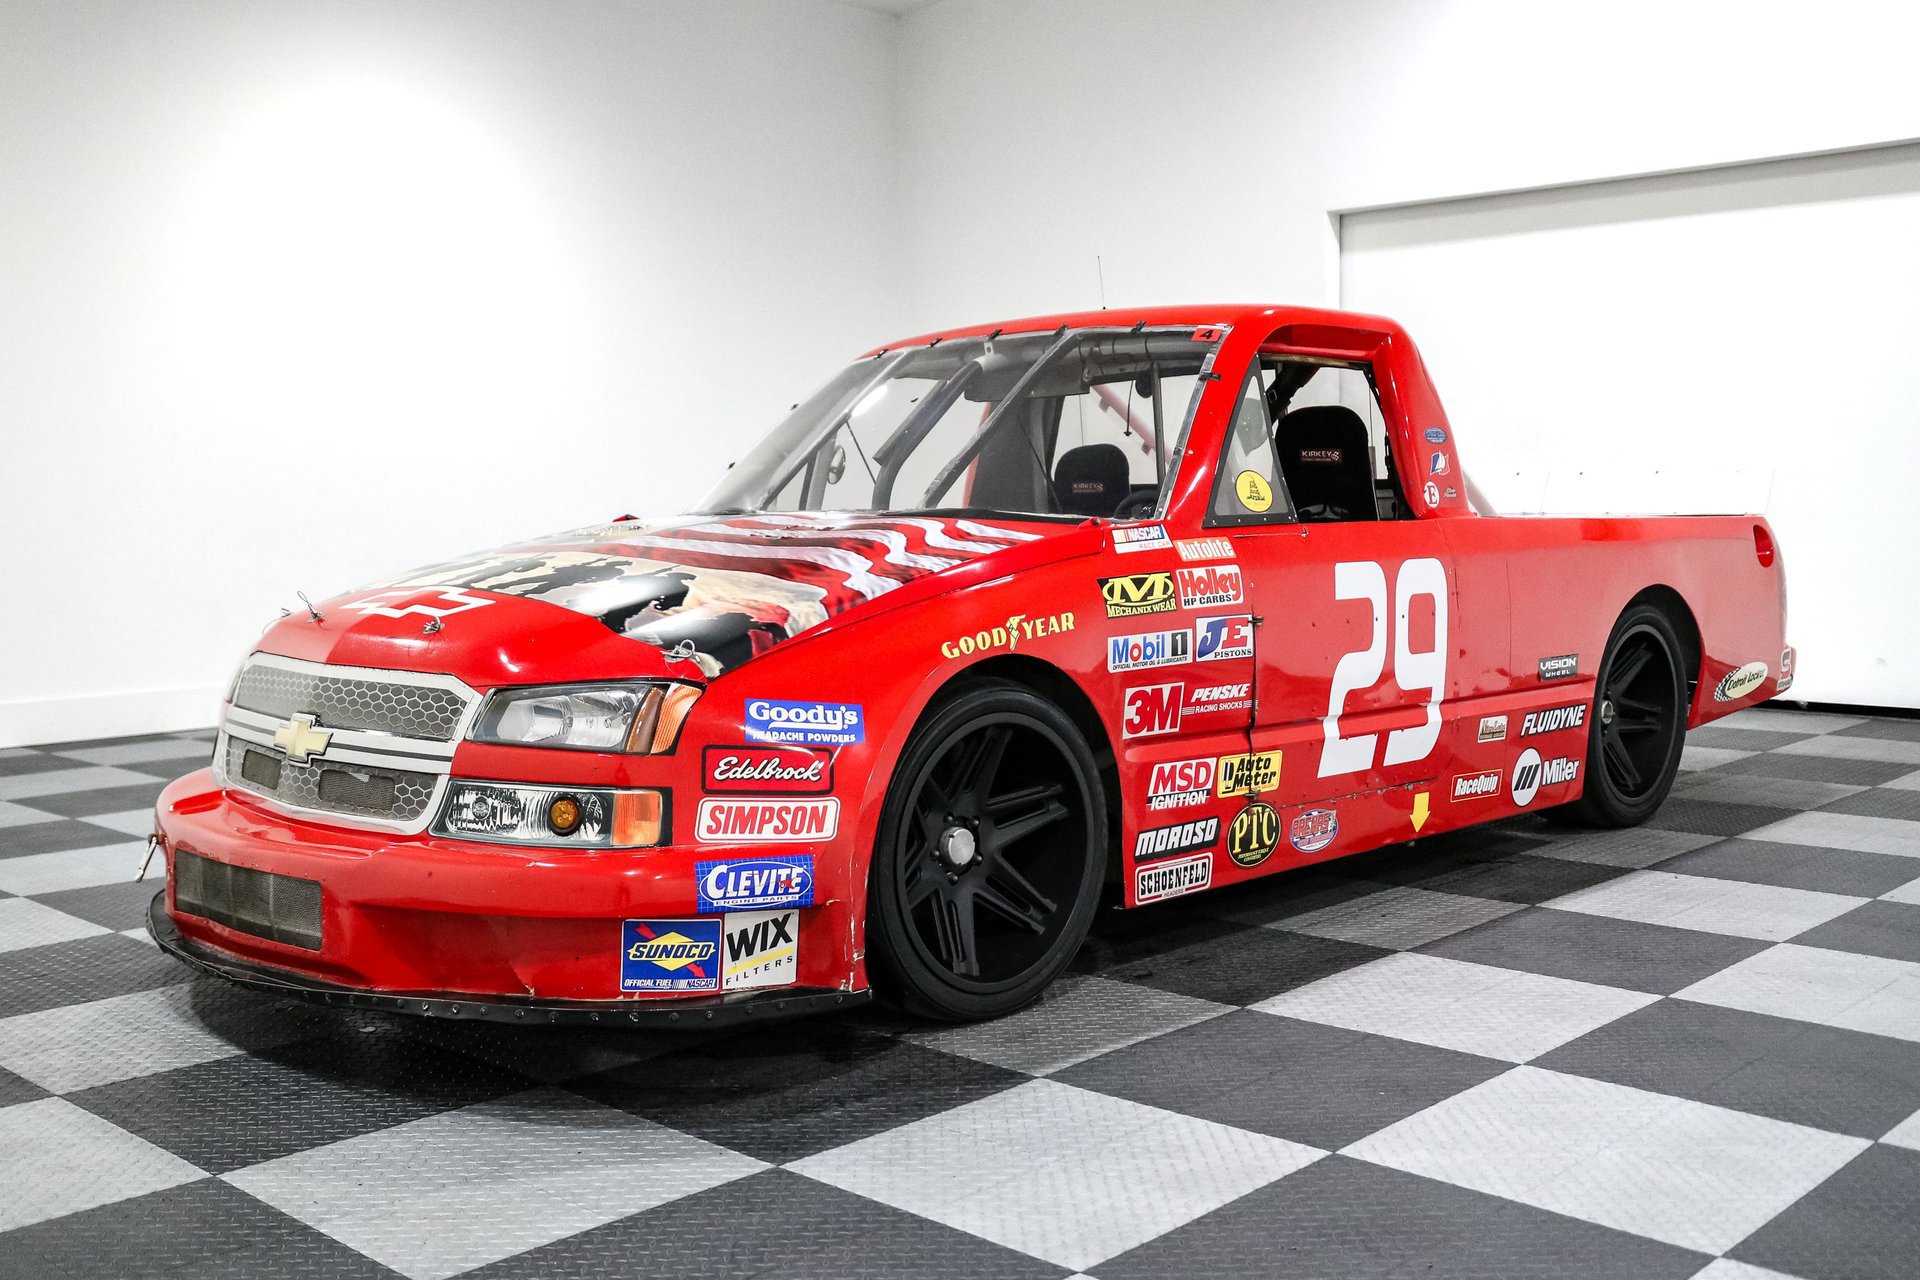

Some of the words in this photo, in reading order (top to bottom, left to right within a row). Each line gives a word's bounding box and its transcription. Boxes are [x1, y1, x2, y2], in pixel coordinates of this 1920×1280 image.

[1198, 329, 1214, 340] 4
[1128, 525, 1162, 541] NASCAR
[1158, 540, 1171, 548] CAR
[1176, 539, 1234, 560] Autolite
[1178, 568, 1242, 601] Holley
[1106, 604, 1153, 618] MECHANIX
[1152, 598, 1177, 613] WEAR
[1183, 596, 1197, 607] HP
[1199, 594, 1232, 605] CARBS
[1197, 617, 1250, 659] JE
[1112, 634, 1165, 664] Mobil
[1214, 648, 1253, 659] PISTONS
[1112, 663, 1131, 671] OFFICIAL
[1161, 656, 1188, 664] LUBRICANTS
[1317, 558, 1448, 779] 29
[1540, 657, 1577, 670] VISION
[1545, 670, 1570, 678] WHEEL
[1191, 683, 1251, 702] PENSKE
[749, 701, 858, 731] Goody's
[1125, 686, 1182, 735] 3M
[1195, 703, 1218, 713] RACING
[1219, 701, 1243, 711] SHOCKS
[1520, 704, 1587, 737] FLUIDYNE
[752, 731, 805, 741] HEADACHE
[807, 732, 856, 743] POWDERS
[713, 756, 825, 781] Edelbrock
[1235, 757, 1272, 773] Auto
[1542, 757, 1579, 786] Miller
[1153, 761, 1212, 795] MSD
[1234, 771, 1277, 788] Meter
[1454, 774, 1498, 796] RaceQuip
[1150, 792, 1207, 810] IGNITION
[706, 805, 828, 835] SIMPSON
[1232, 806, 1276, 854] PTC
[1135, 818, 1219, 857] MOROSO
[706, 865, 805, 899] CLEVITE
[1140, 862, 1207, 896] SCHOENFELD
[1163, 888, 1184, 898] HEADERS
[726, 913, 793, 963] WIX
[632, 944, 711, 960] SUNOCO
[725, 956, 793, 985] FILTERS
[624, 979, 654, 987] OFFICIAL
[655, 979, 672, 988] FUEL
[686, 978, 716, 988] NASCAR
